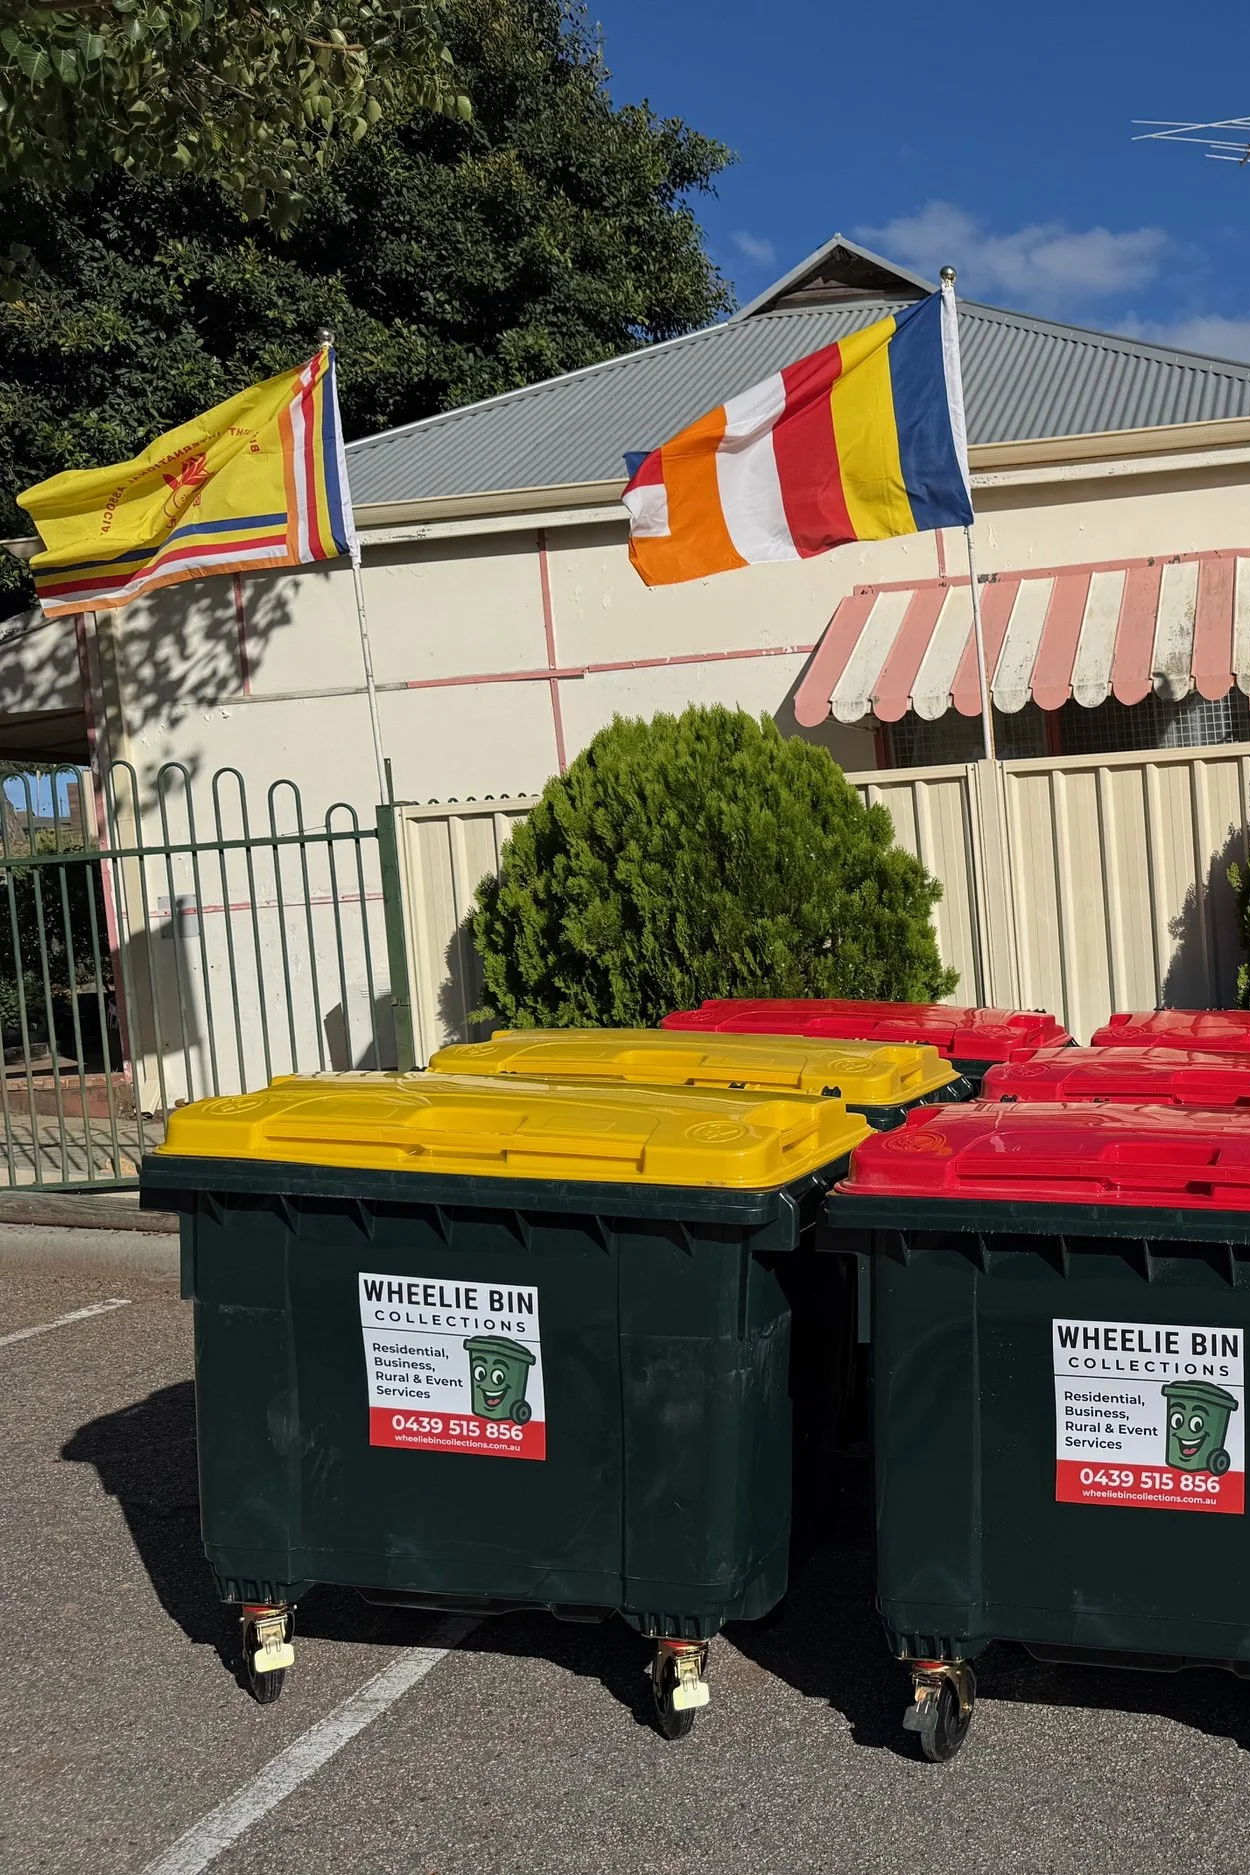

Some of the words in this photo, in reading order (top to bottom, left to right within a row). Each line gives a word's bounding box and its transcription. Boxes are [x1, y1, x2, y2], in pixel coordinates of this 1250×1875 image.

[364, 1279, 478, 1310] WHEELIE
[490, 1290, 533, 1314] BIN
[375, 1310, 525, 1332] COLLECTIONS
[1058, 1326, 1179, 1354] WHEELIE
[1192, 1333, 1238, 1357] BIN
[373, 1343, 449, 1359] Residential,
[375, 1357, 435, 1372] Business,
[1069, 1357, 1229, 1377] COLLECTIONS
[376, 1371, 409, 1383] Rural
[414, 1374, 422, 1383] &
[426, 1375, 463, 1387] Event
[377, 1386, 430, 1399] Services
[1065, 1391, 1144, 1407] Residential,
[1065, 1406, 1129, 1420] Business,
[392, 1415, 442, 1433] 0439
[449, 1420, 480, 1437] 515
[486, 1424, 523, 1440] 856
[1065, 1421, 1101, 1433] Rural
[1105, 1424, 1114, 1433] &
[1119, 1425, 1158, 1436] Event
[395, 1435, 520, 1451] wheeliebincollections.com.au
[1065, 1437, 1122, 1449] Services
[1080, 1468, 1133, 1487] 0439
[1140, 1472, 1173, 1490] 515
[1180, 1476, 1220, 1493] 856
[1083, 1489, 1216, 1505] wheeliebincollections.com.au
